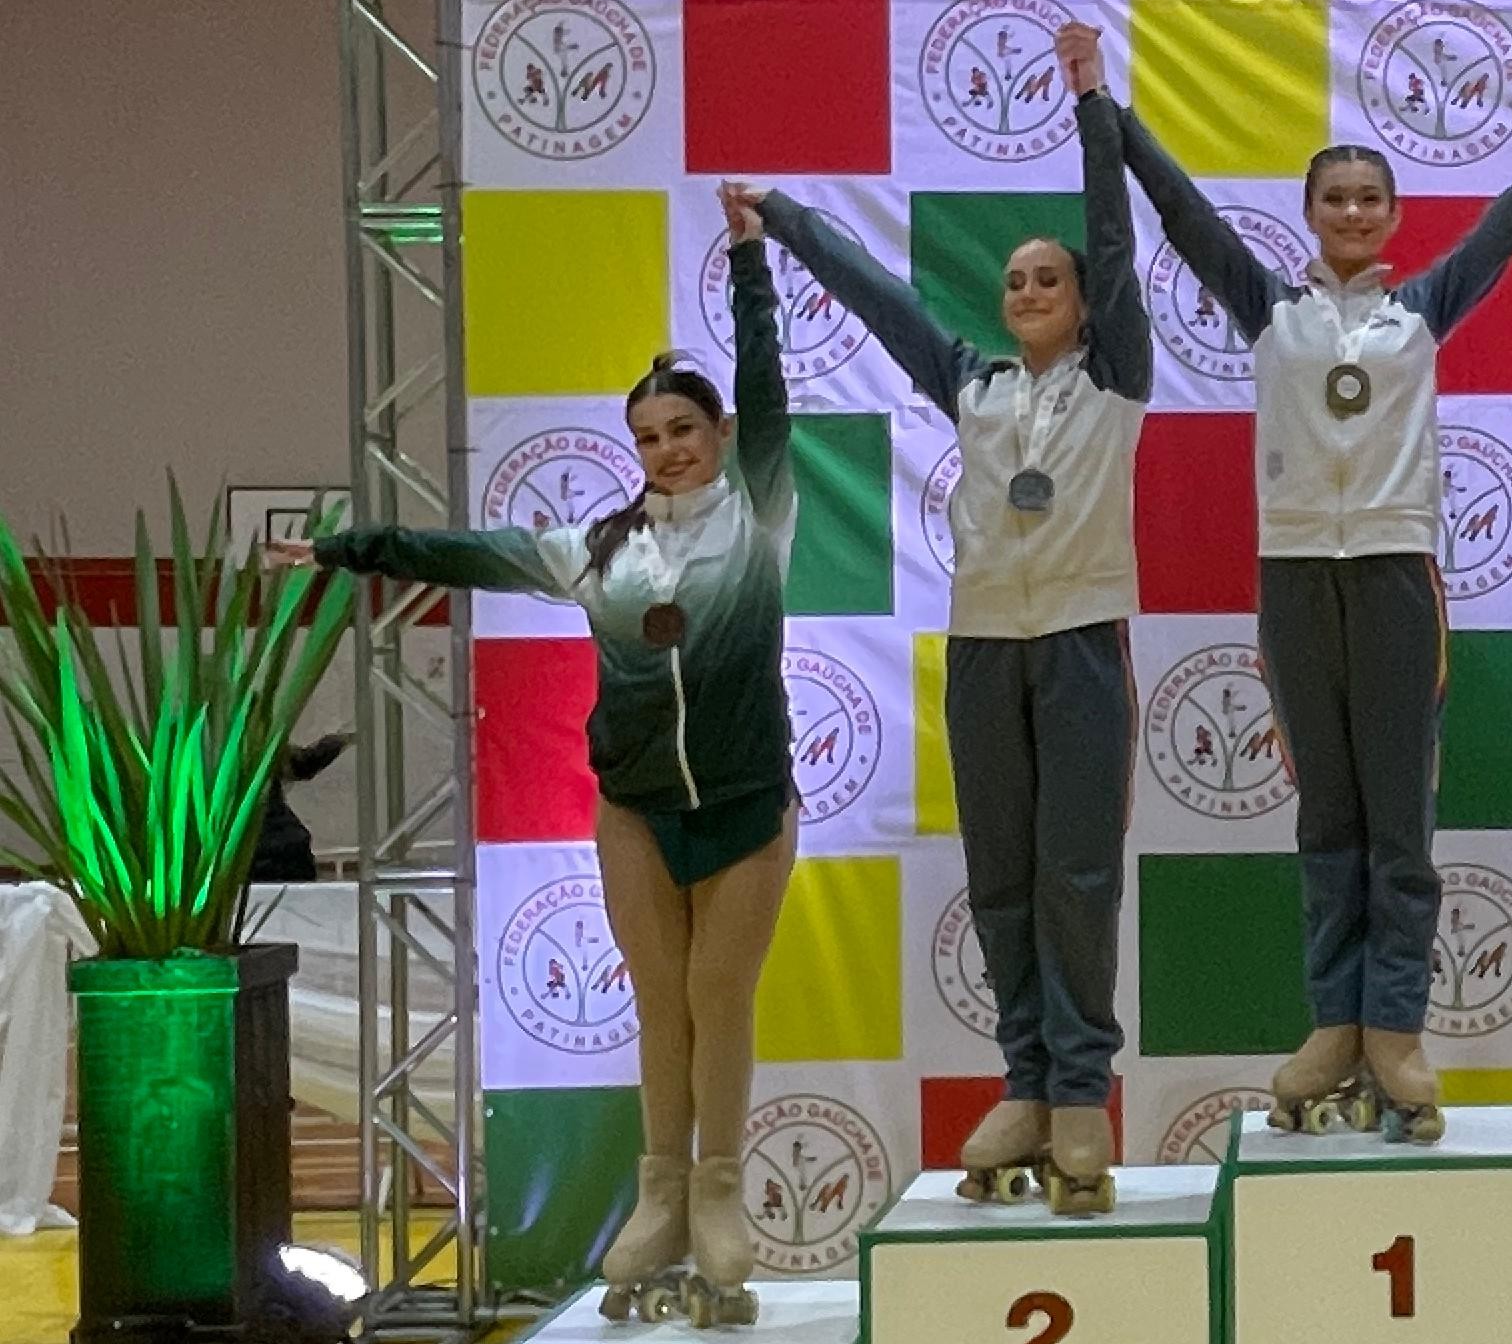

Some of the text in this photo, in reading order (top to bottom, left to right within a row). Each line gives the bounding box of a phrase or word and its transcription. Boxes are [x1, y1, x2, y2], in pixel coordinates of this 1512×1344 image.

[498, 113, 632, 154] PATINAGEM
[942, 115, 1073, 156] PATINAGEM
[1382, 119, 1508, 160] PATINAGEM
[487, 436, 570, 520] FEDERAÇÃO
[1151, 652, 1232, 733] FEDERAÇÃO
[1168, 774, 1283, 813] PATINAGE
[504, 884, 584, 966] FEDERAÇÃO
[520, 1008, 636, 1047] PATINAGE
[1371, 1234, 1416, 1318] 1
